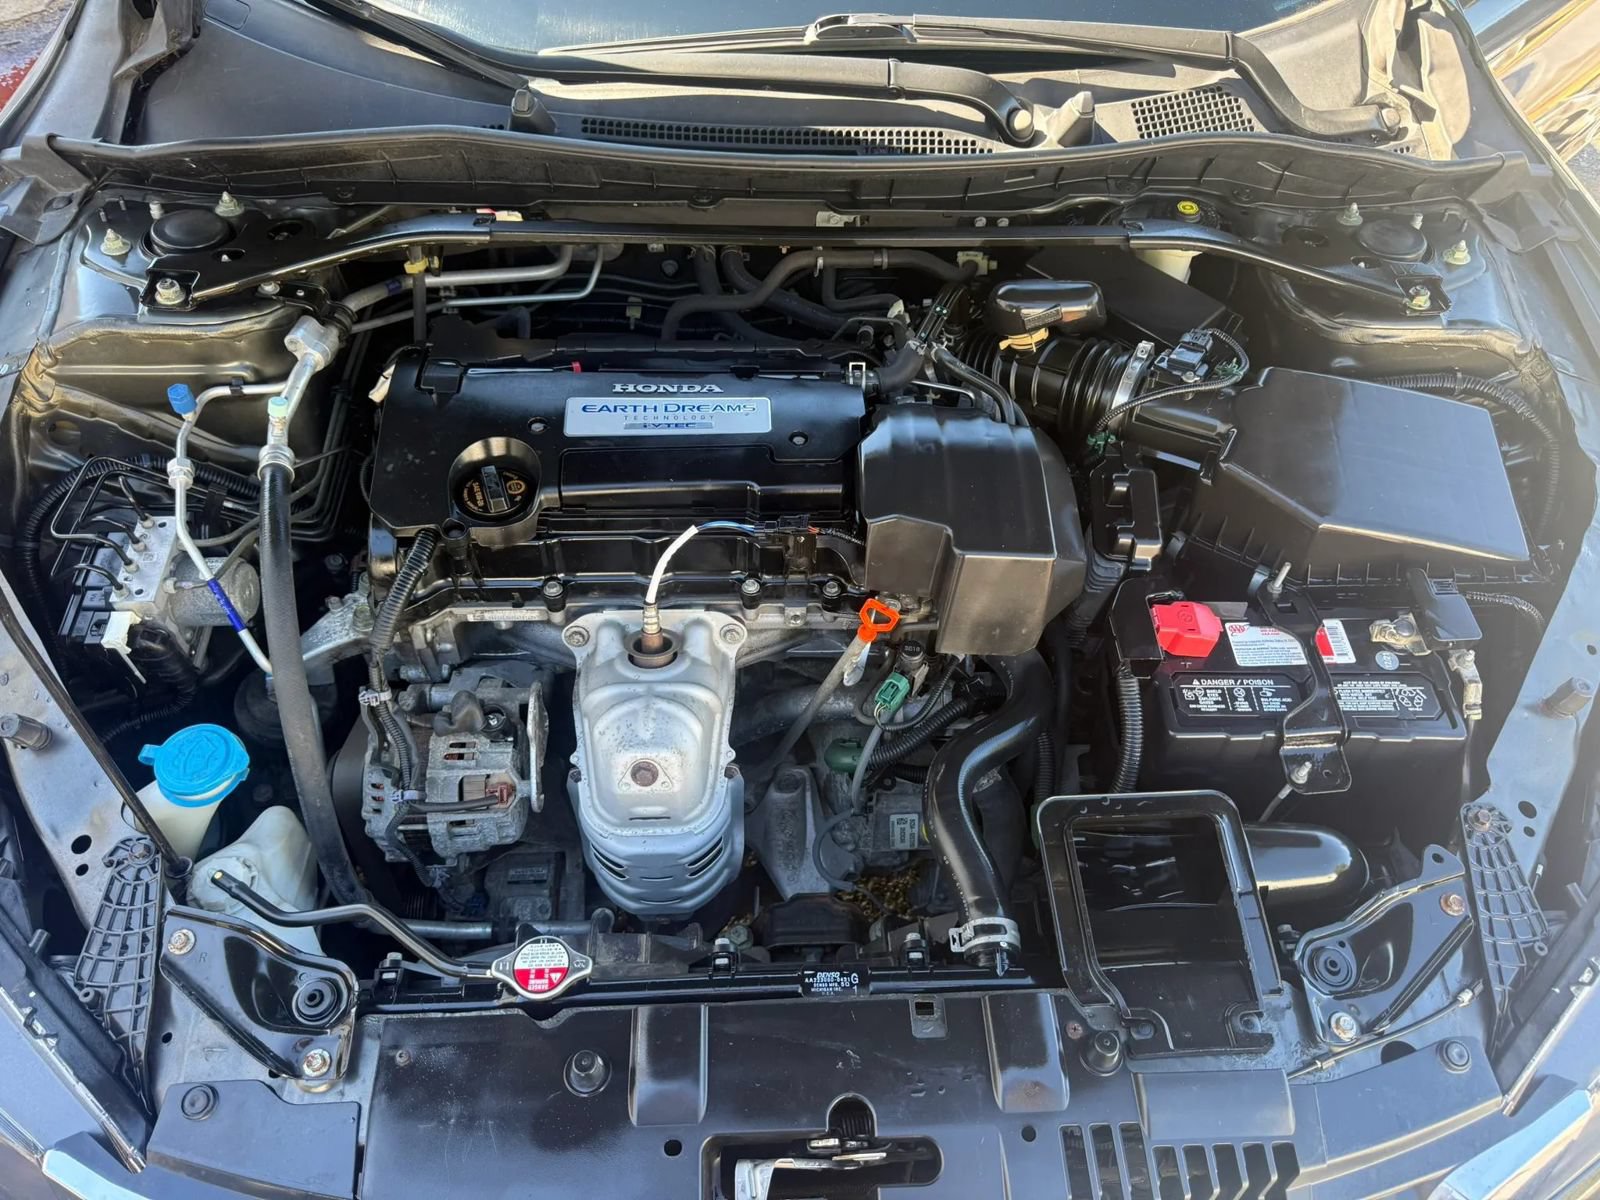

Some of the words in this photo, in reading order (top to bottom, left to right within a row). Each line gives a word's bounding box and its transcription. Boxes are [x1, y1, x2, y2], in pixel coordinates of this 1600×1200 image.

[612, 383, 723, 393] HONDA
[581, 404, 658, 413] EARTH
[663, 403, 756, 413] DREAMS
[850, 973, 859, 984] G
